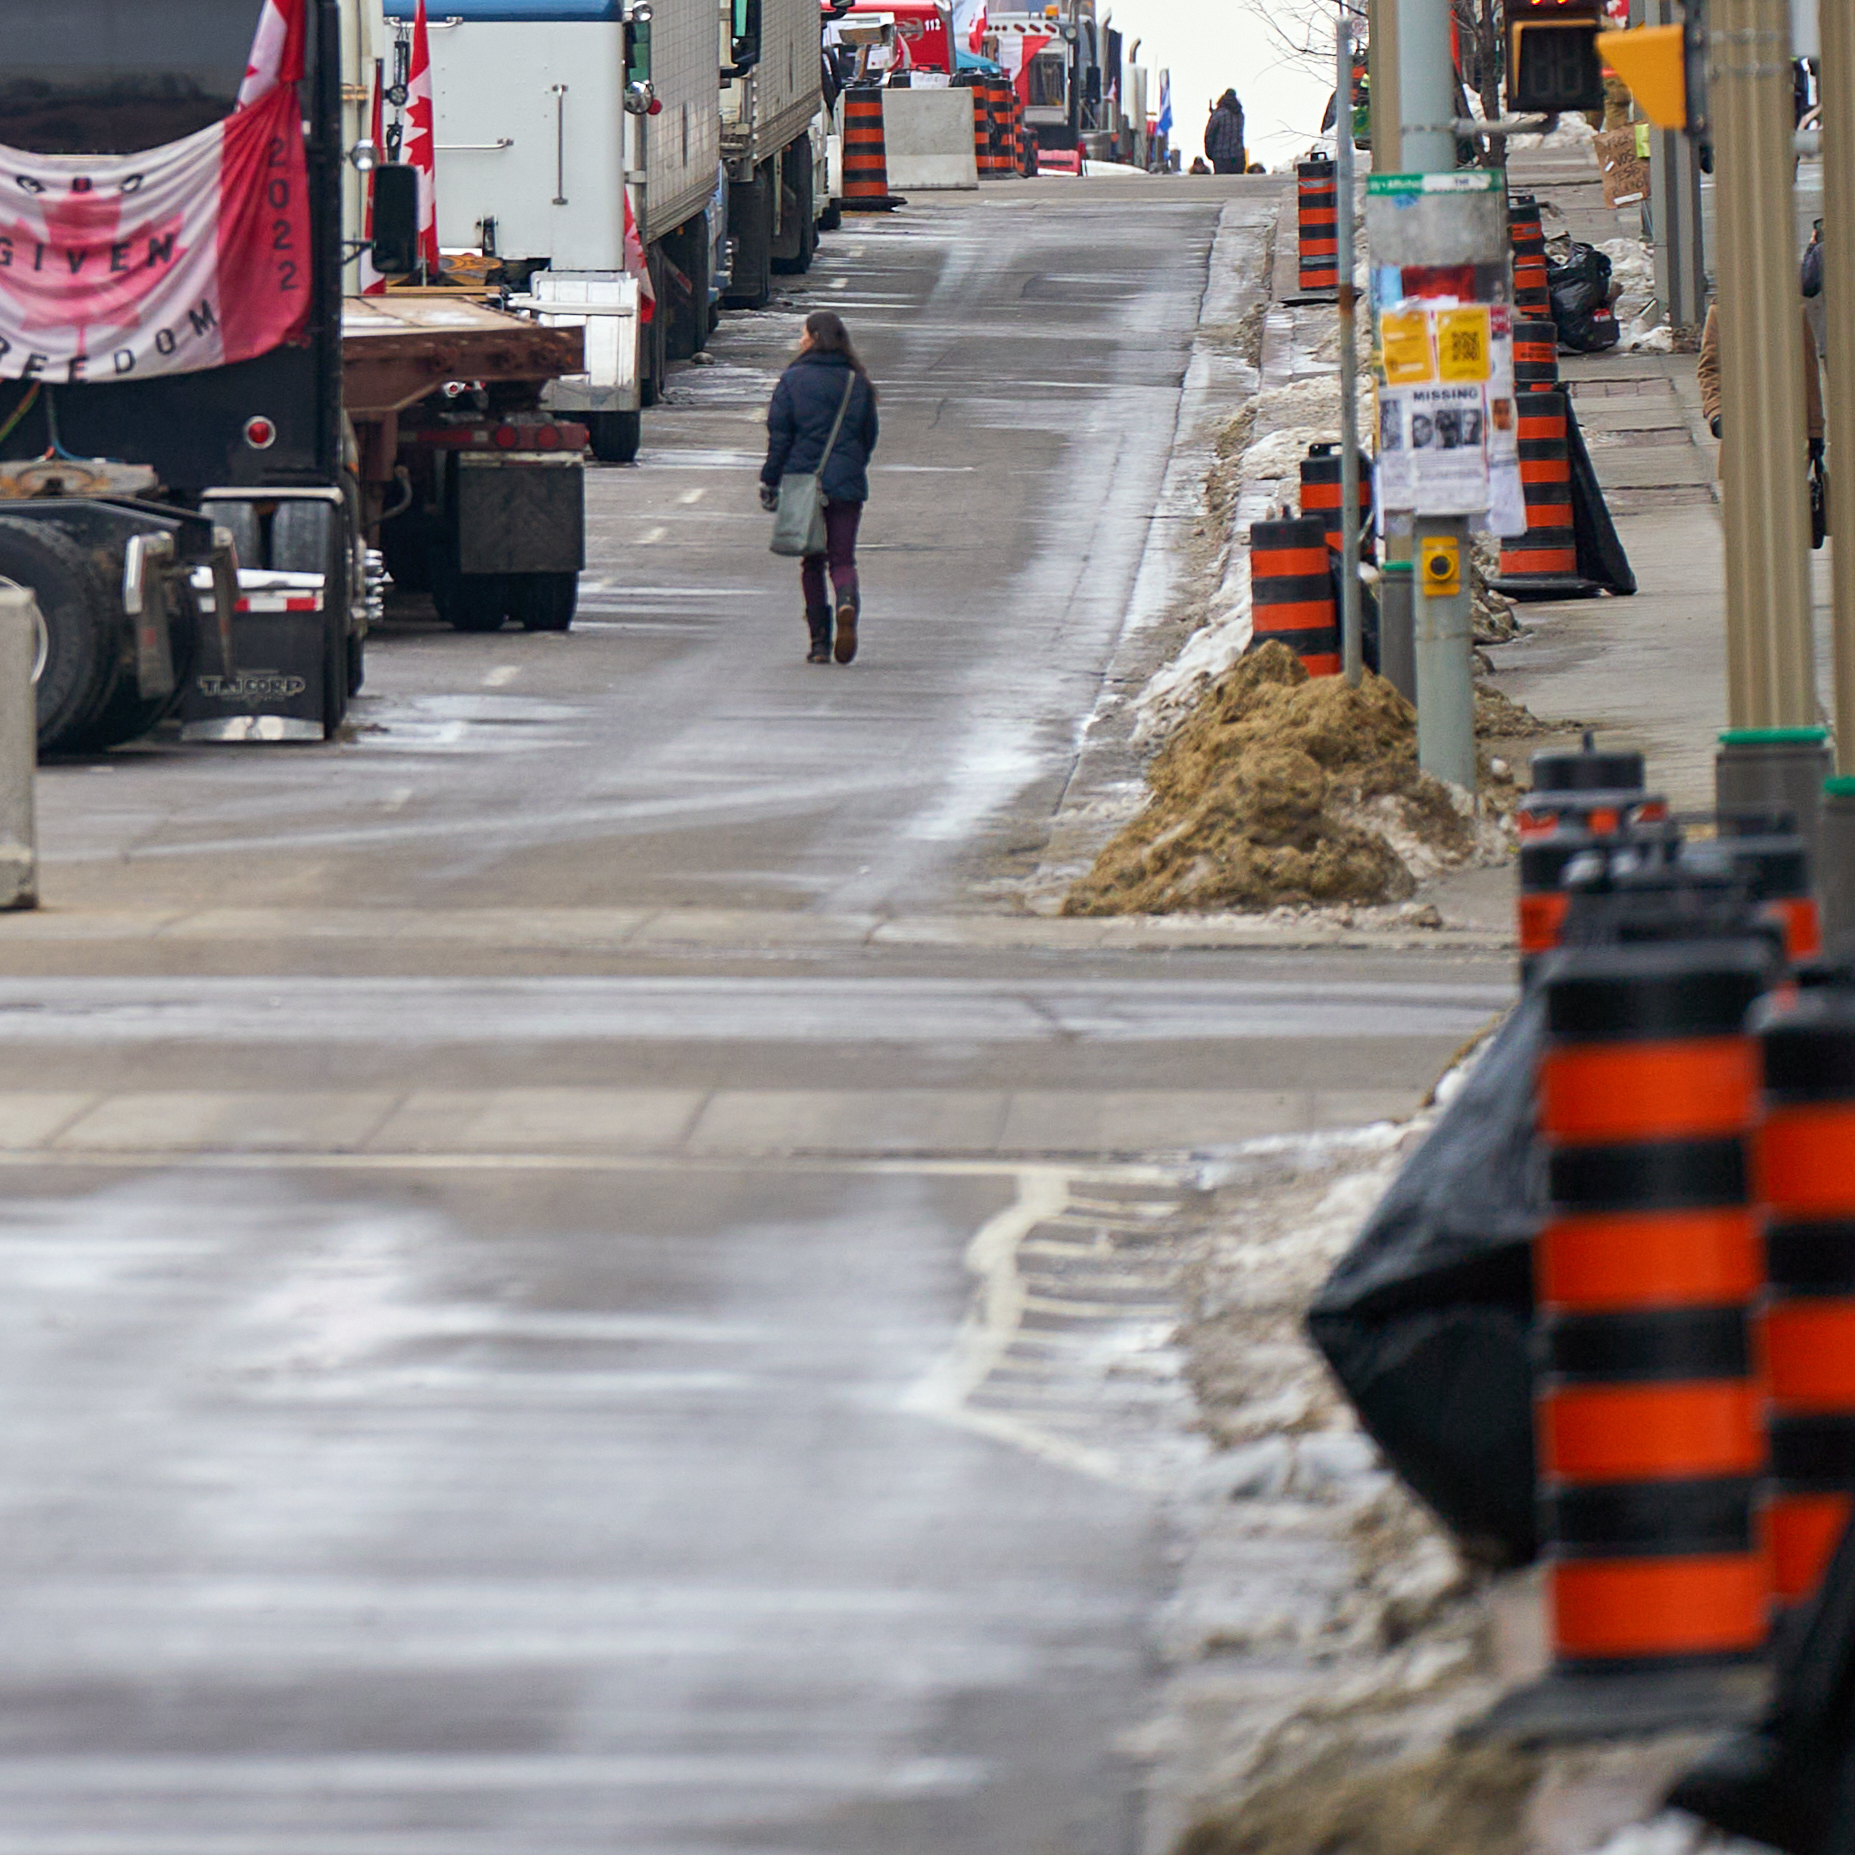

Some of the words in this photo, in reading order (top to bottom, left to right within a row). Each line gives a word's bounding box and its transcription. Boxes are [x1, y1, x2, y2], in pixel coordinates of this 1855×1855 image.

[924, 18, 941, 31] 112
[266, 137, 299, 292] 2022
[1413, 387, 1478, 402] MISSING
